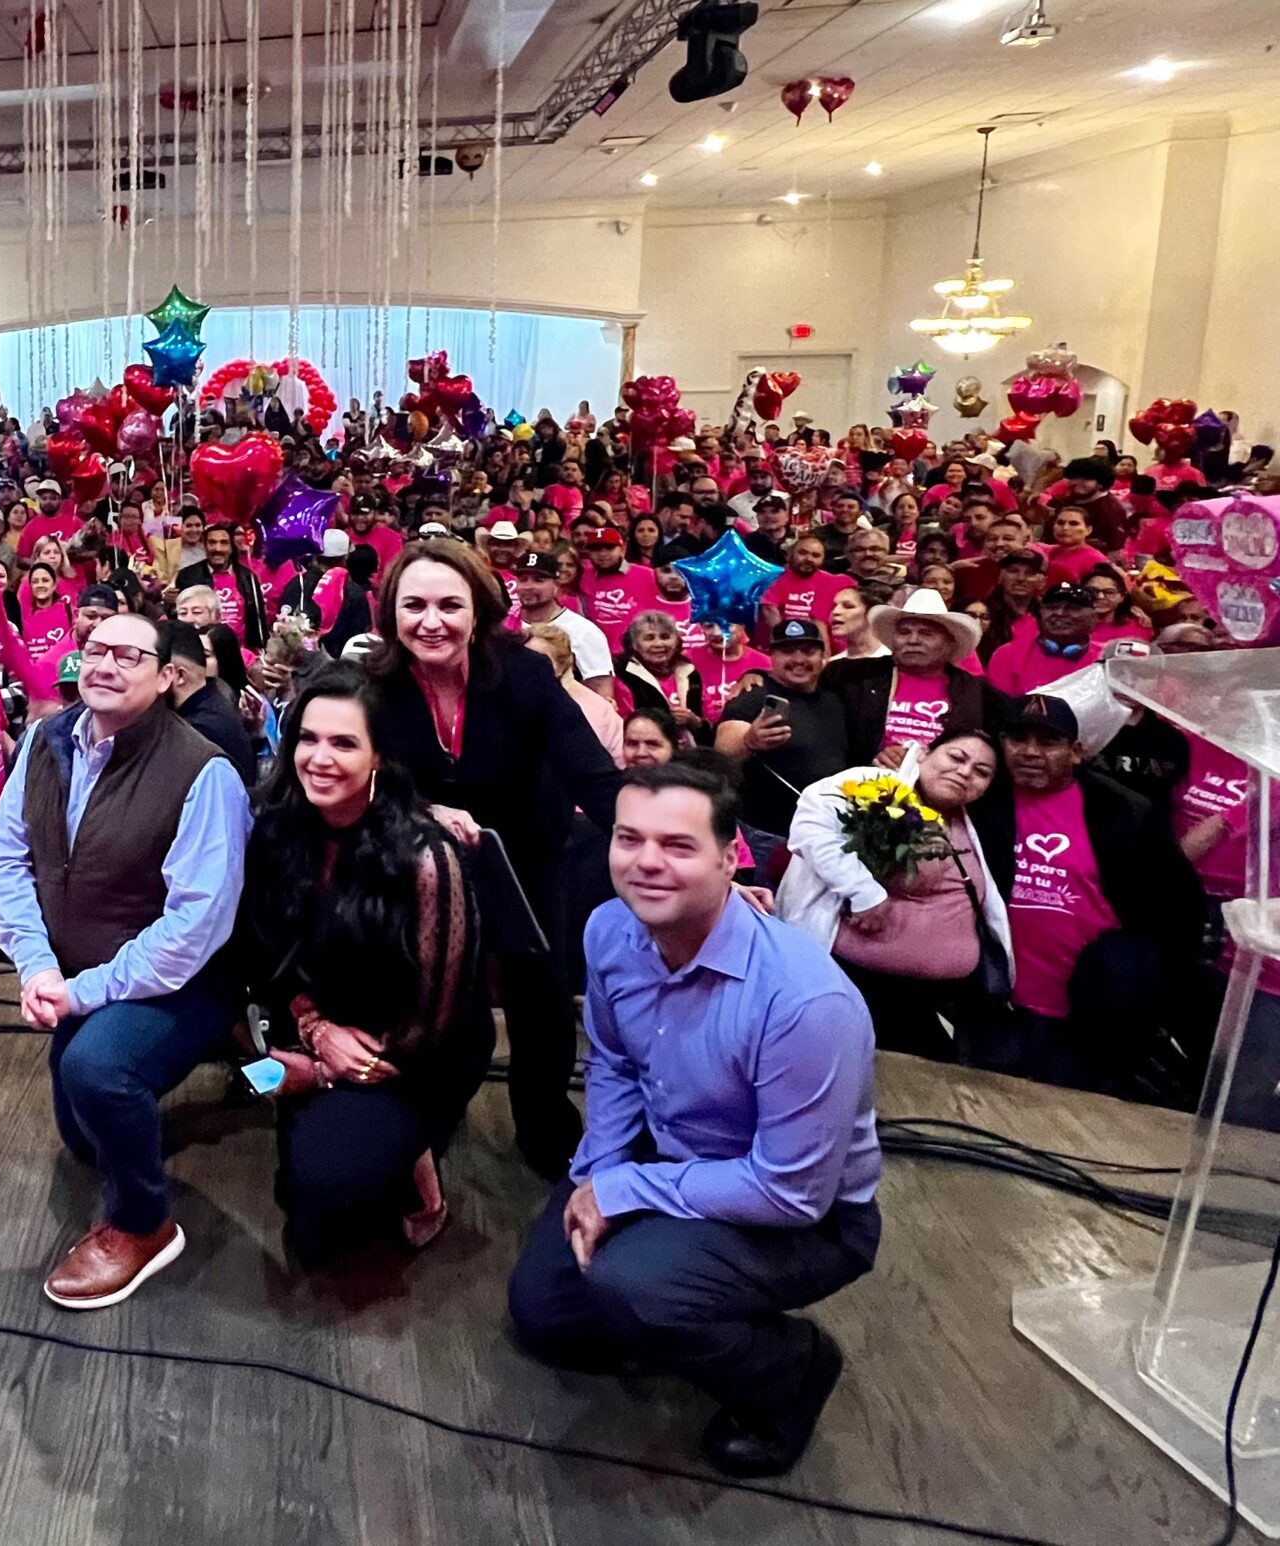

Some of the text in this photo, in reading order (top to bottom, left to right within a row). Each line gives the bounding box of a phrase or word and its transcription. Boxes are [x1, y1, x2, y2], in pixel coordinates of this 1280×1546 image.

[526, 553, 538, 567] B
[1030, 863, 1067, 878] para
[1035, 877, 1051, 888] tu
